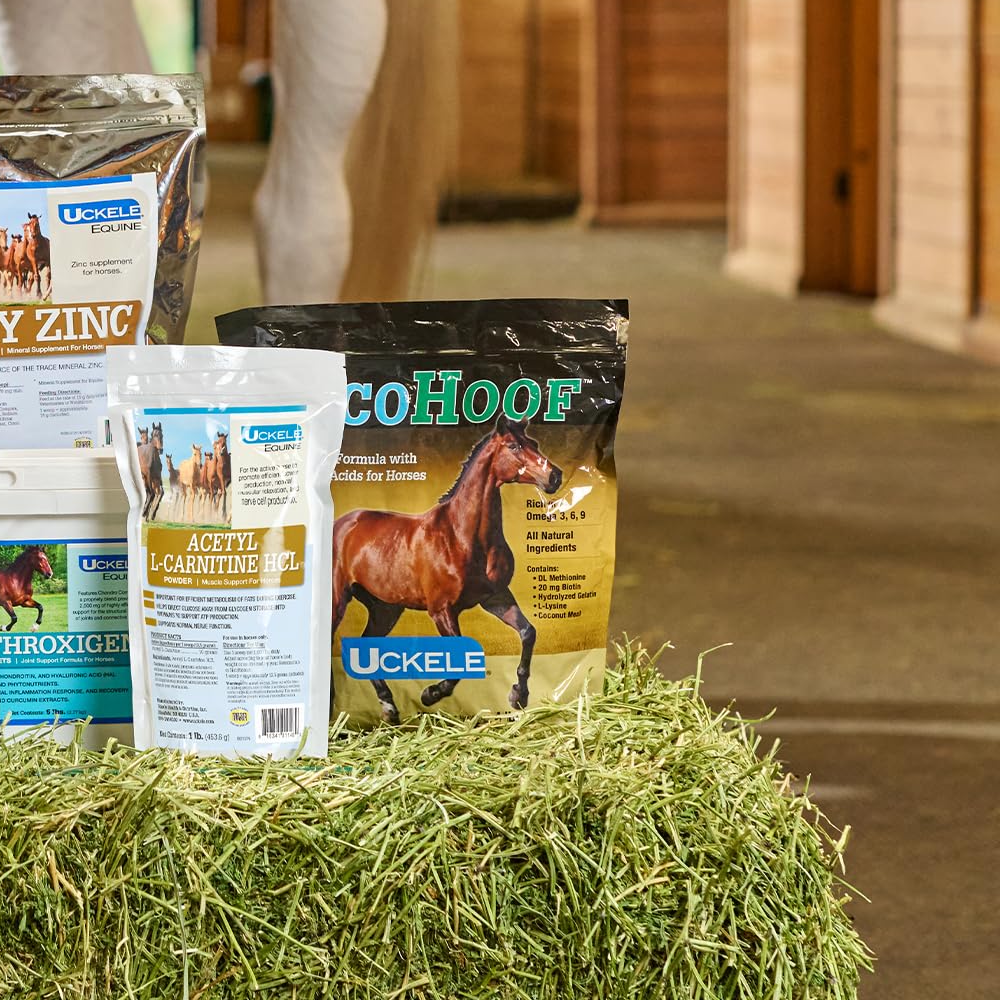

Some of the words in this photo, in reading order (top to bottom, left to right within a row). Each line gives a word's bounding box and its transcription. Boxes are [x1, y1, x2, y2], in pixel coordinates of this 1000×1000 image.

[64, 205, 140, 222] UCKELE
[92, 222, 142, 234] EQUINE
[90, 258, 132, 267] supplement
[35, 304, 134, 341] ZINC
[31, 346, 69, 354] Supplement
[346, 370, 582, 426] COHOOF
[245, 430, 302, 442] UCKELE
[337, 453, 386, 464] Formula
[389, 453, 417, 464] with
[331, 470, 363, 481] Acids
[367, 470, 383, 481] for
[386, 470, 426, 480] Horses
[526, 512, 556, 522] Omega
[560, 512, 568, 521] 3,
[570, 511, 578, 521] 6,
[581, 511, 586, 519] 9
[526, 532, 538, 540] All
[541, 531, 573, 540] Natural
[187, 532, 258, 552] ACETYL
[526, 543, 576, 554] Ingredients
[83, 559, 128, 570] UCKEL
[151, 553, 258, 574] L-CARNITINE
[263, 552, 299, 572] HCL
[164, 576, 192, 584] POWDER
[538, 593, 576, 601] Hydrolyzed
[350, 648, 485, 674] UCKELE
